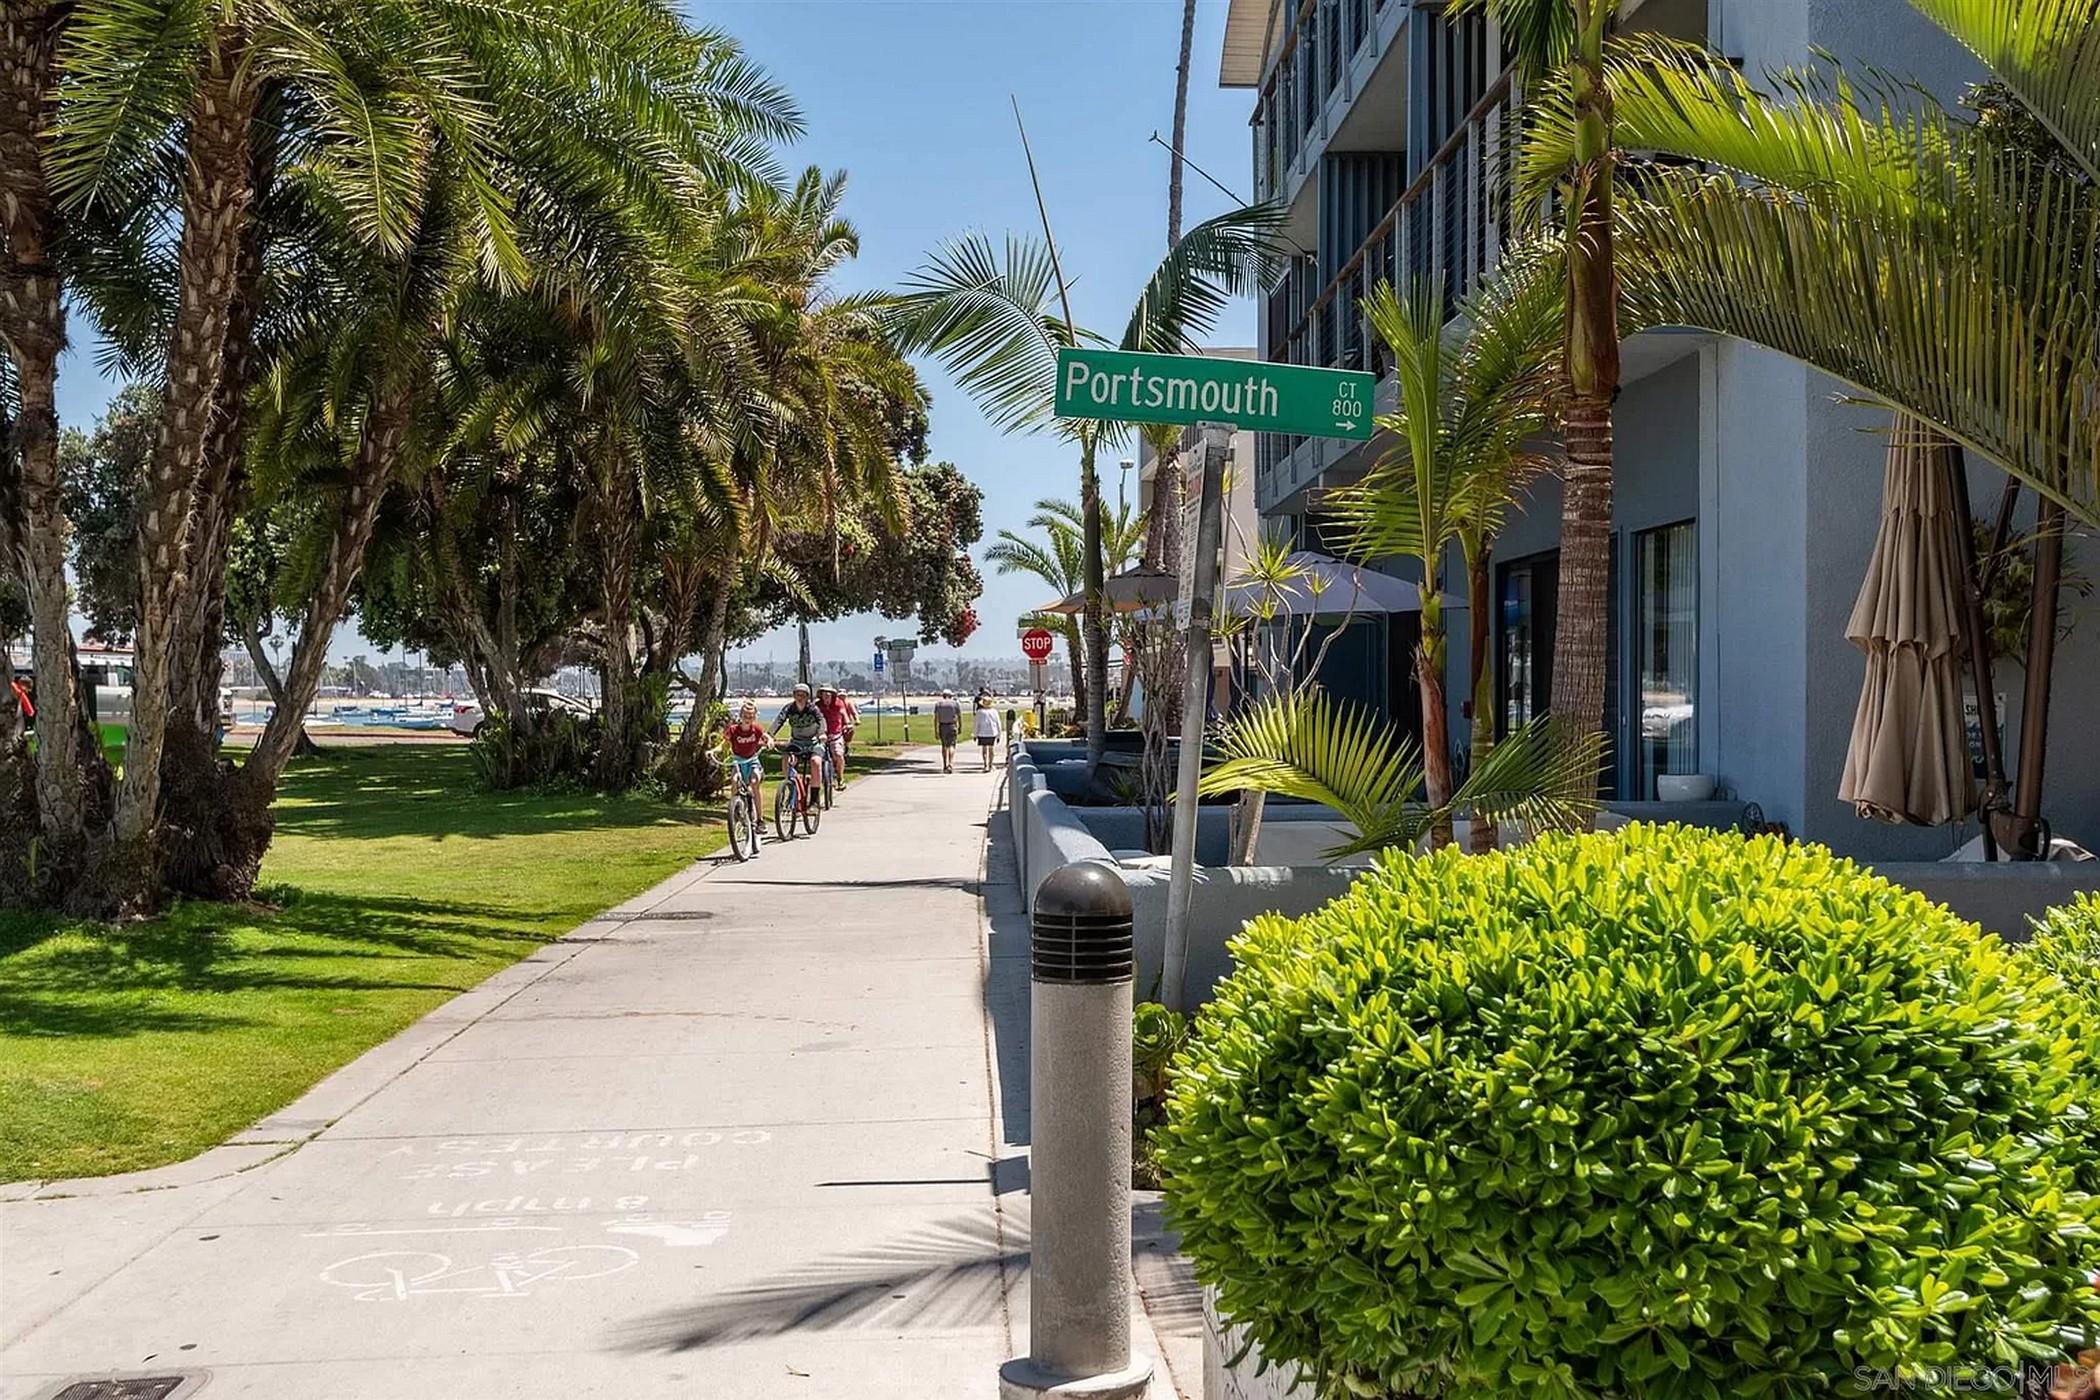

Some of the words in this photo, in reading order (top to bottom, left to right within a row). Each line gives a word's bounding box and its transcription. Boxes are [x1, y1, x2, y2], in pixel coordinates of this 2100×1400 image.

[1065, 361, 1279, 417] Portsmouth
[1338, 381, 1357, 398] CT
[1331, 400, 1362, 418] 800
[1024, 637, 1051, 650] STOP
[387, 1130, 772, 1157] COURTESY
[398, 1154, 699, 1180] PLEASE
[428, 1195, 592, 1217] mph
